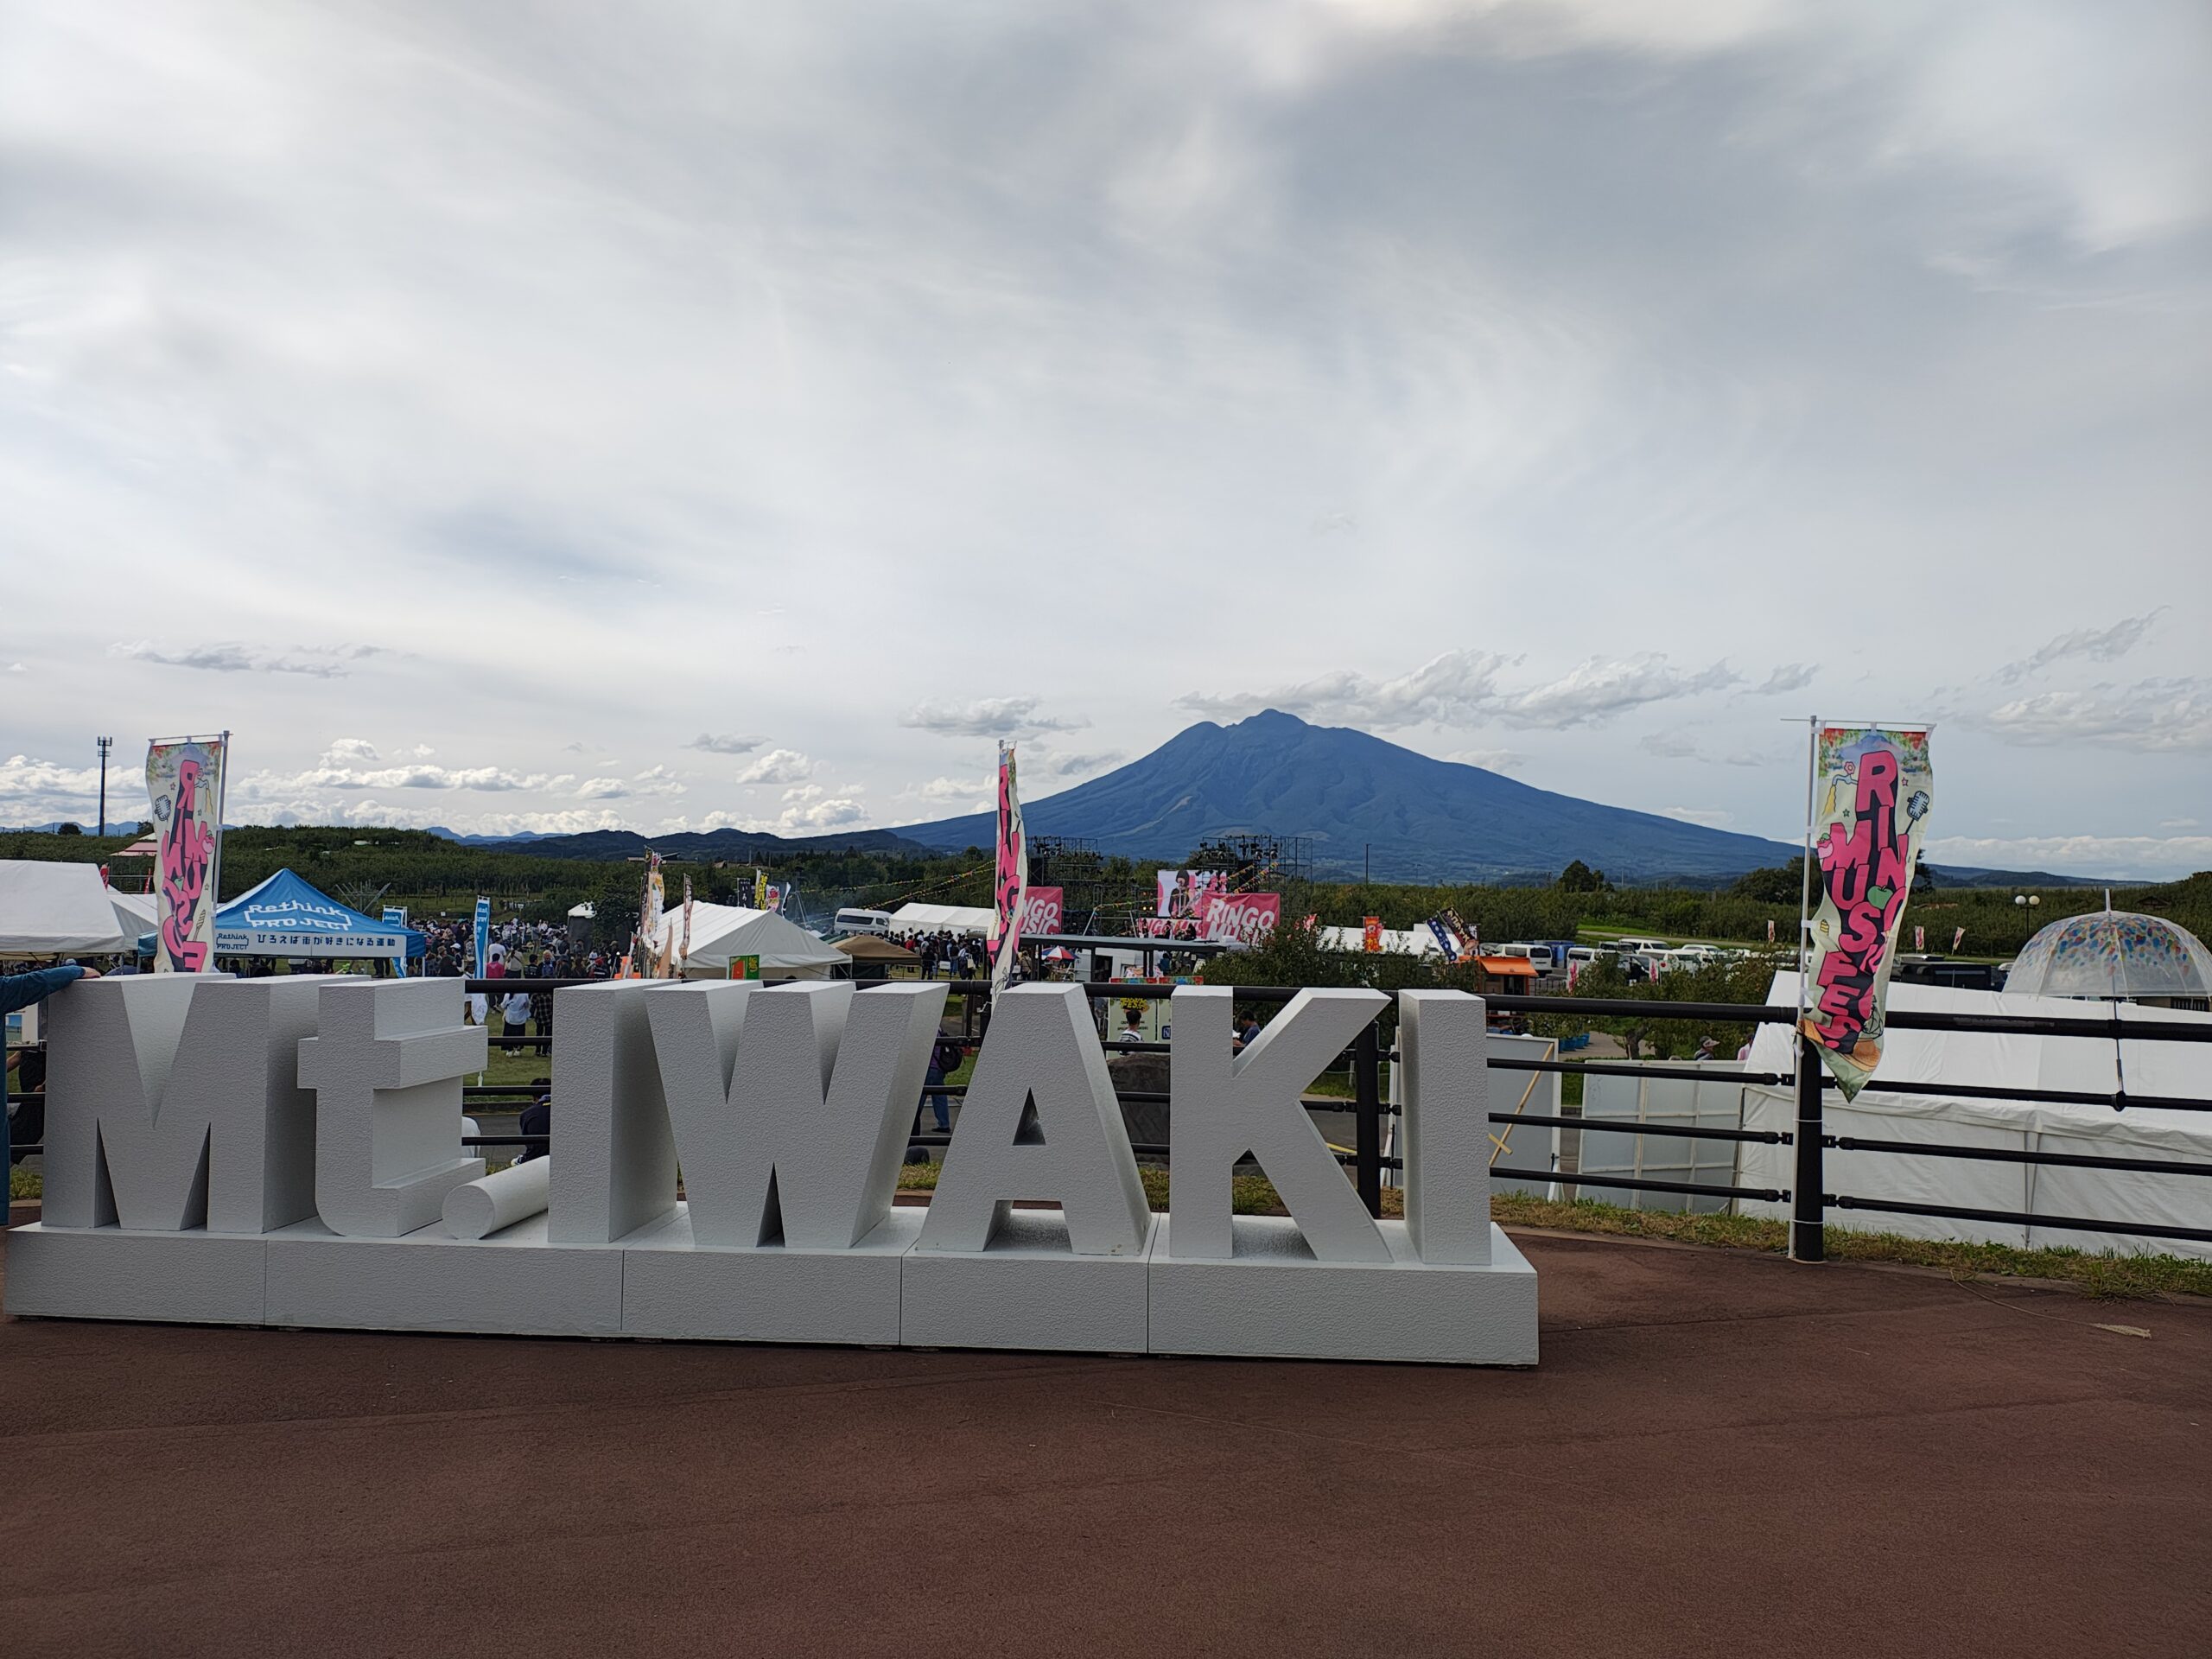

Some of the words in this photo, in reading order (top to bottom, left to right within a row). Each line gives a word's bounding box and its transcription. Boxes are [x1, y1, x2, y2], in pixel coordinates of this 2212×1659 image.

[247, 899, 343, 917] Rethink
[1023, 896, 1058, 921] NGO
[1206, 899, 1275, 931] RINGO
[251, 918, 350, 931] PROJECT
